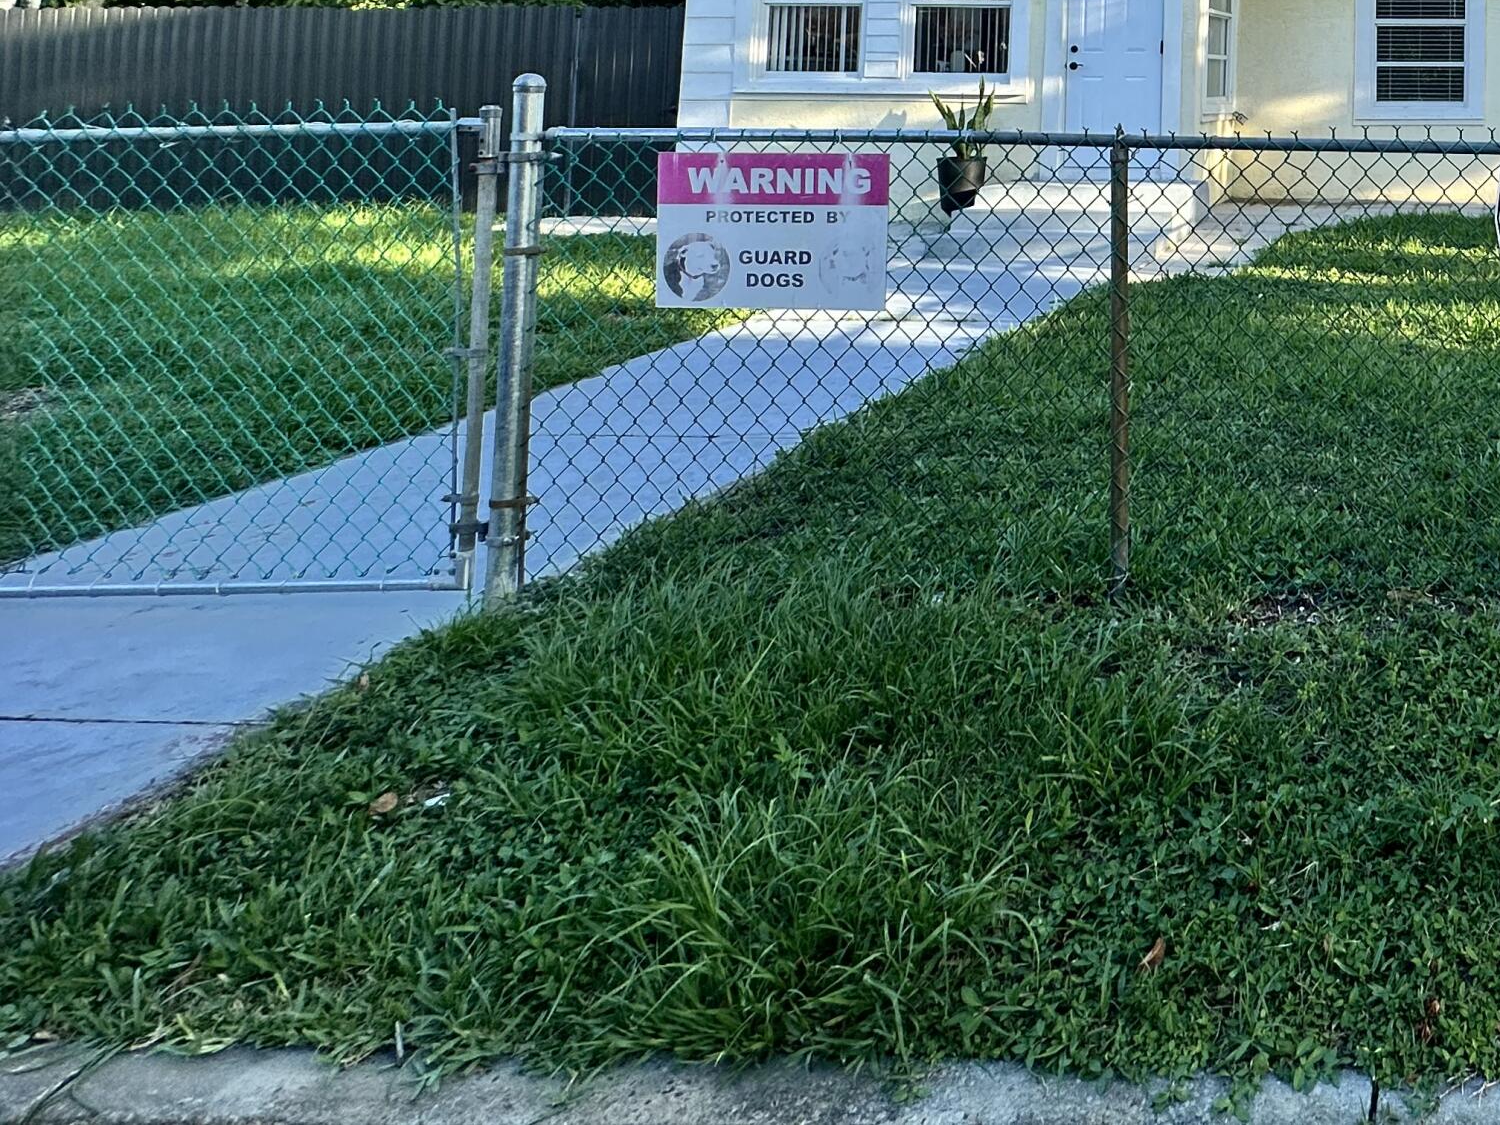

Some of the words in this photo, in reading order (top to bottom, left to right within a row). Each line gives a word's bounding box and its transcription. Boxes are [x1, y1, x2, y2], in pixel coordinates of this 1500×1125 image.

[688, 167, 871, 195] WARNING
[706, 211, 815, 223] PROTECTED
[826, 211, 848, 223] BY
[738, 250, 812, 265] GUARD
[746, 273, 804, 288] DOGS
